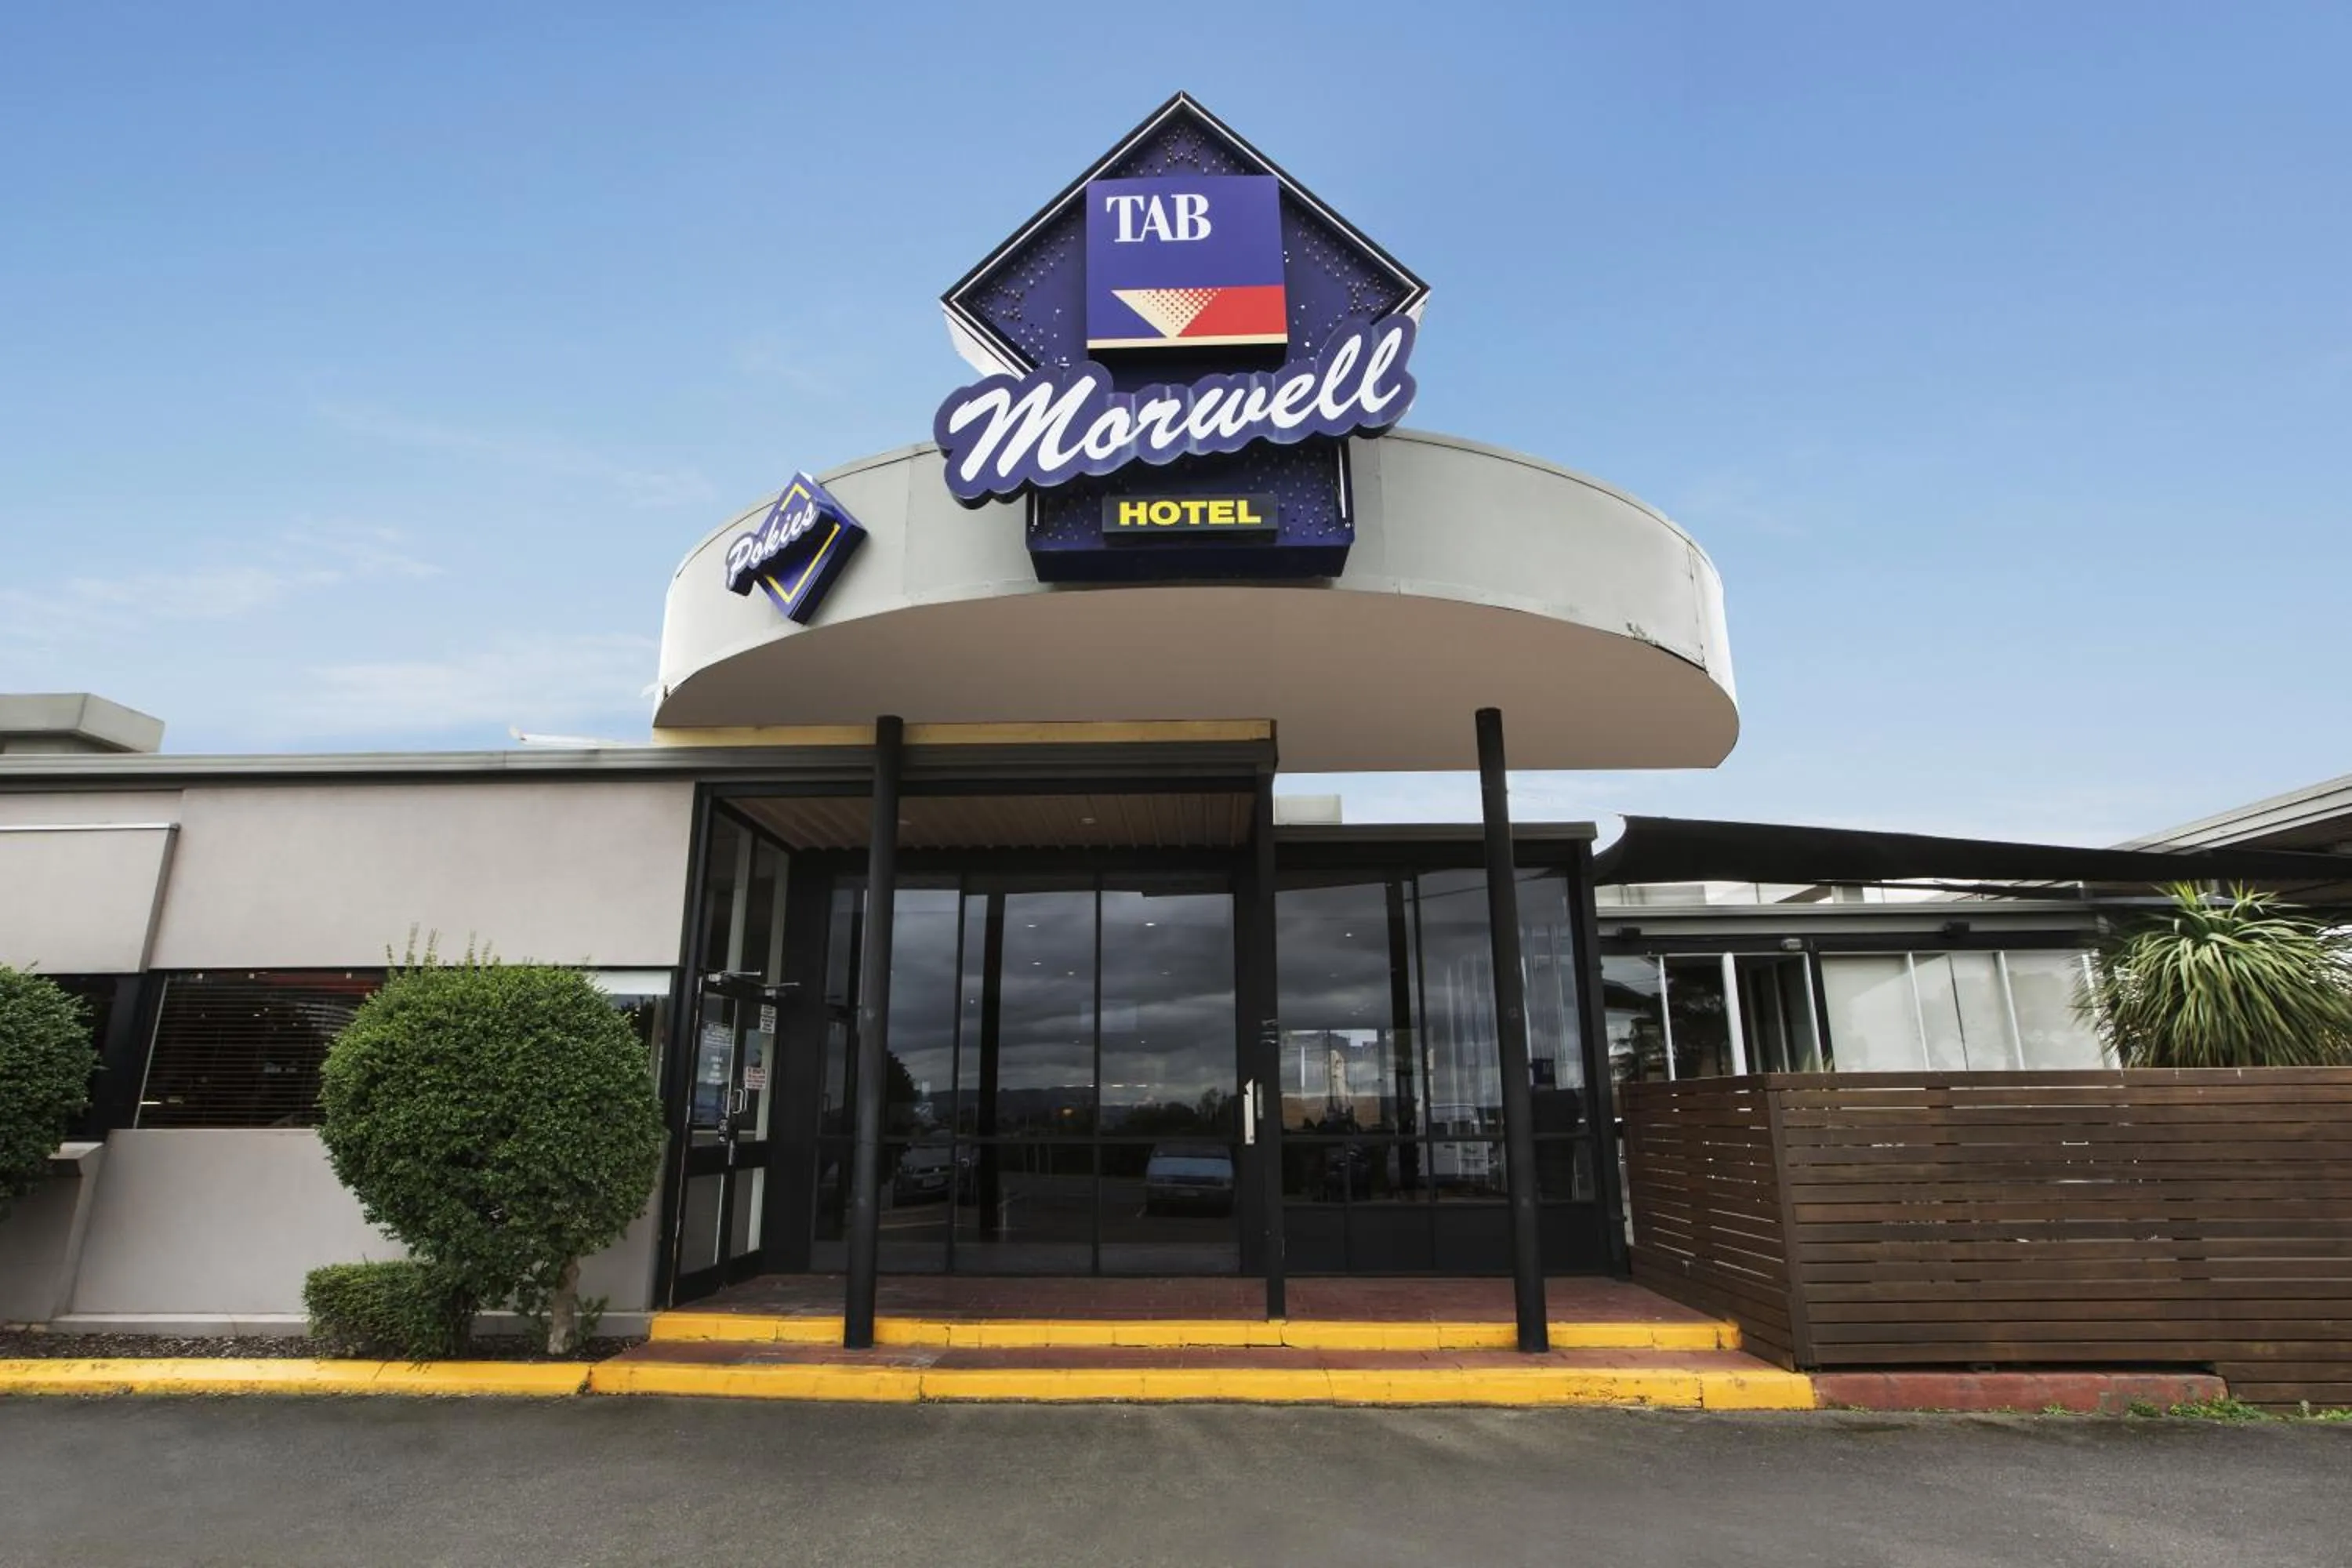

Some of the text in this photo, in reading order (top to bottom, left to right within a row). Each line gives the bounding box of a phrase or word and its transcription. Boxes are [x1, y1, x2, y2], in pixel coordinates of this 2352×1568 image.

[1106, 193, 1211, 242] TAB
[949, 326, 1403, 481] Morwell
[728, 500, 816, 587] Pokies
[1118, 499, 1261, 525] HOTEL
